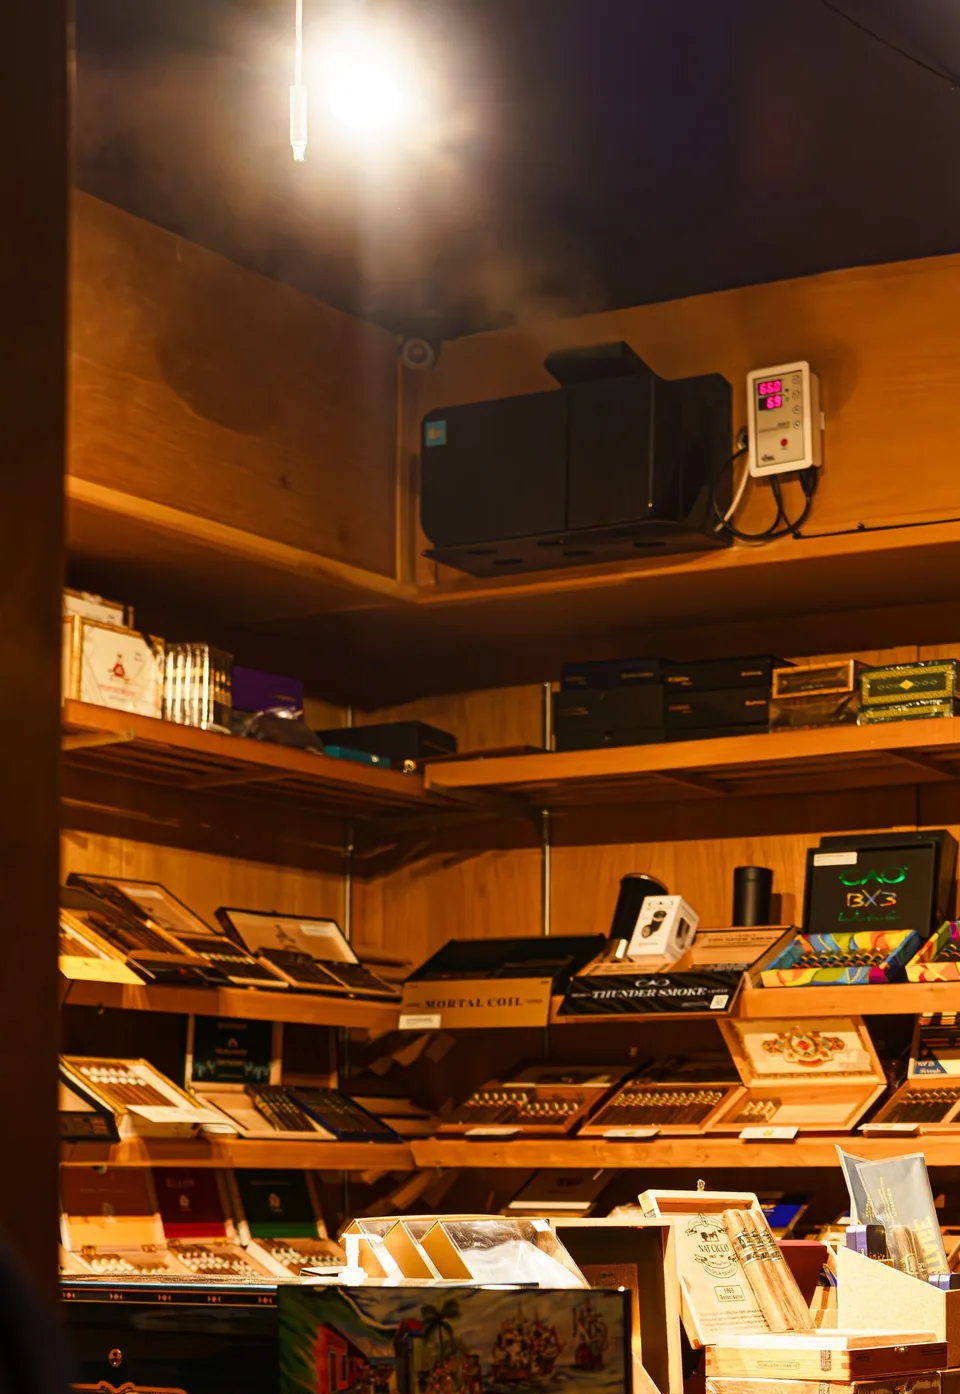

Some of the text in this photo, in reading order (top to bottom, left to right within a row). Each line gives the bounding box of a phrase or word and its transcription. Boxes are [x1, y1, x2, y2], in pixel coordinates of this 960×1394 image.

[839, 866, 906, 886] CAO
[847, 889, 897, 908] BX3
[635, 978, 670, 988] CAO
[591, 987, 708, 1000] THUNDER SMOKE
[425, 997, 524, 1009] MORTAL COIL
